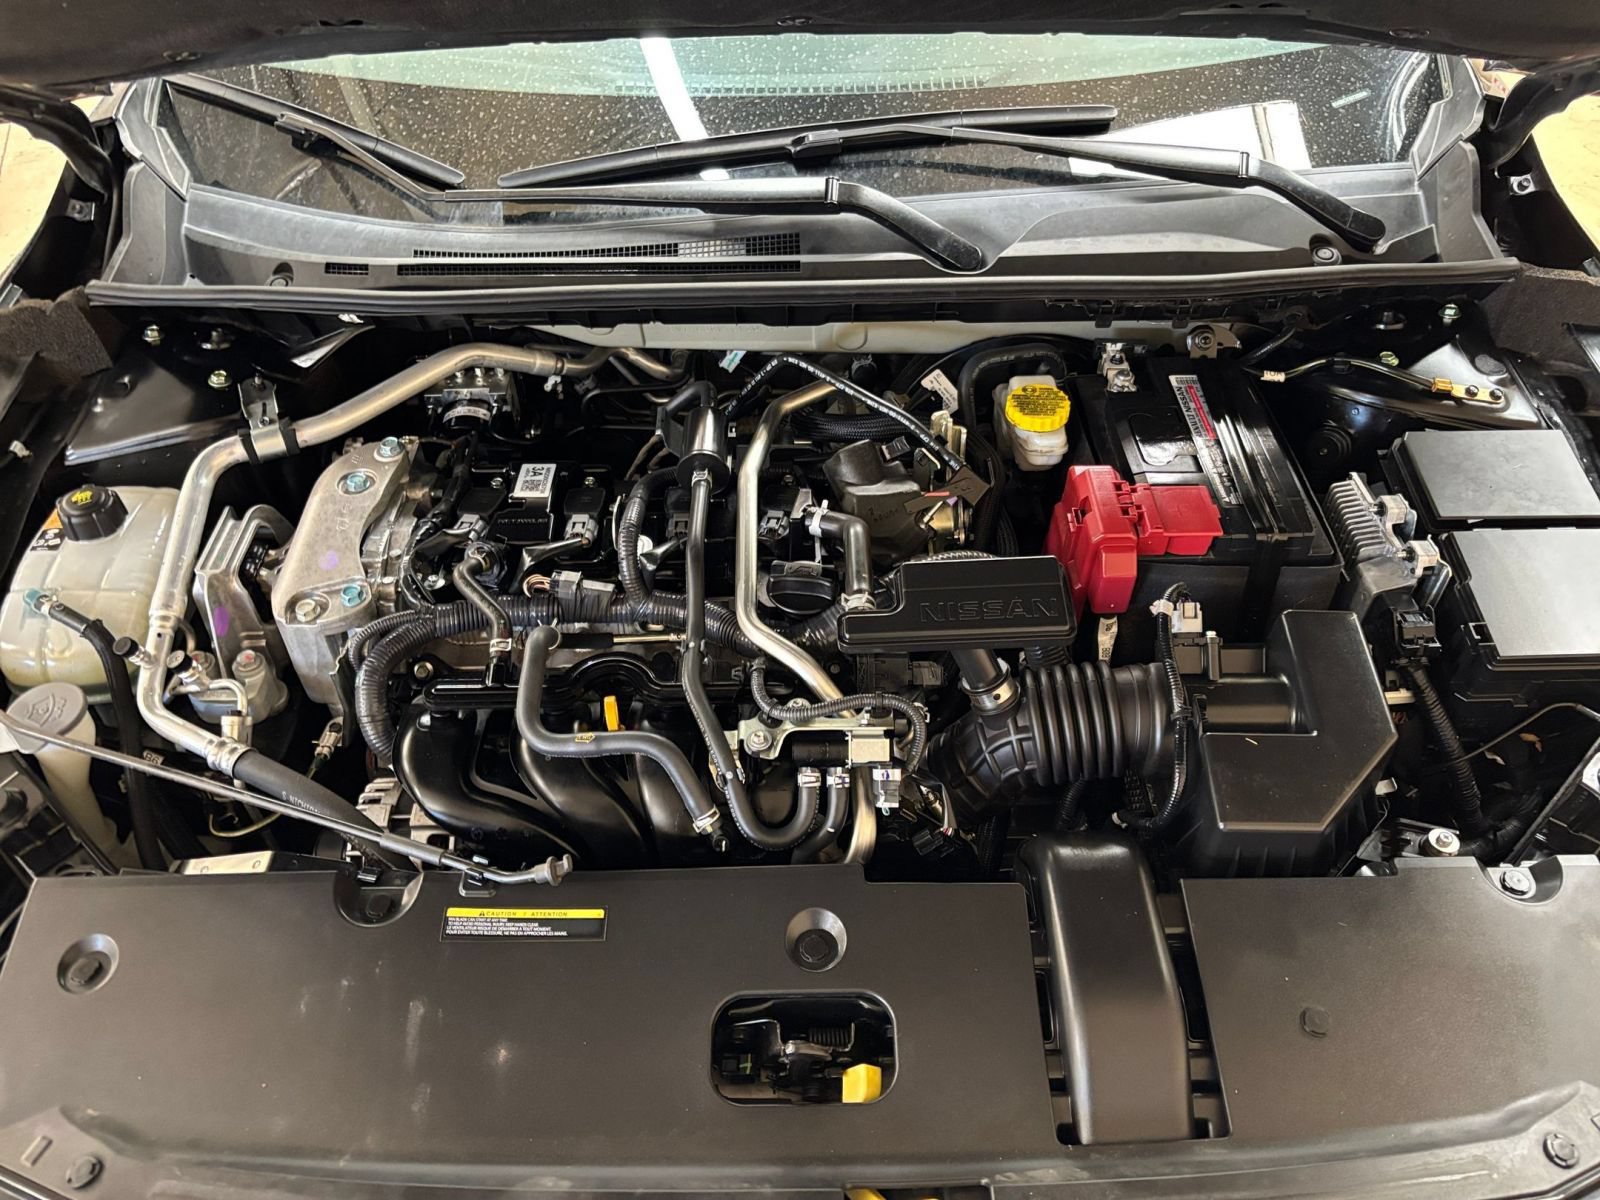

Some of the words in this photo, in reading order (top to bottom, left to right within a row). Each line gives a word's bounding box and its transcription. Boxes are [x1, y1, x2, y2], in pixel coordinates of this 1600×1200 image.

[1174, 386, 1192, 413] NISSAN
[531, 466, 545, 478] 3A
[920, 598, 1058, 622] NISSAN
